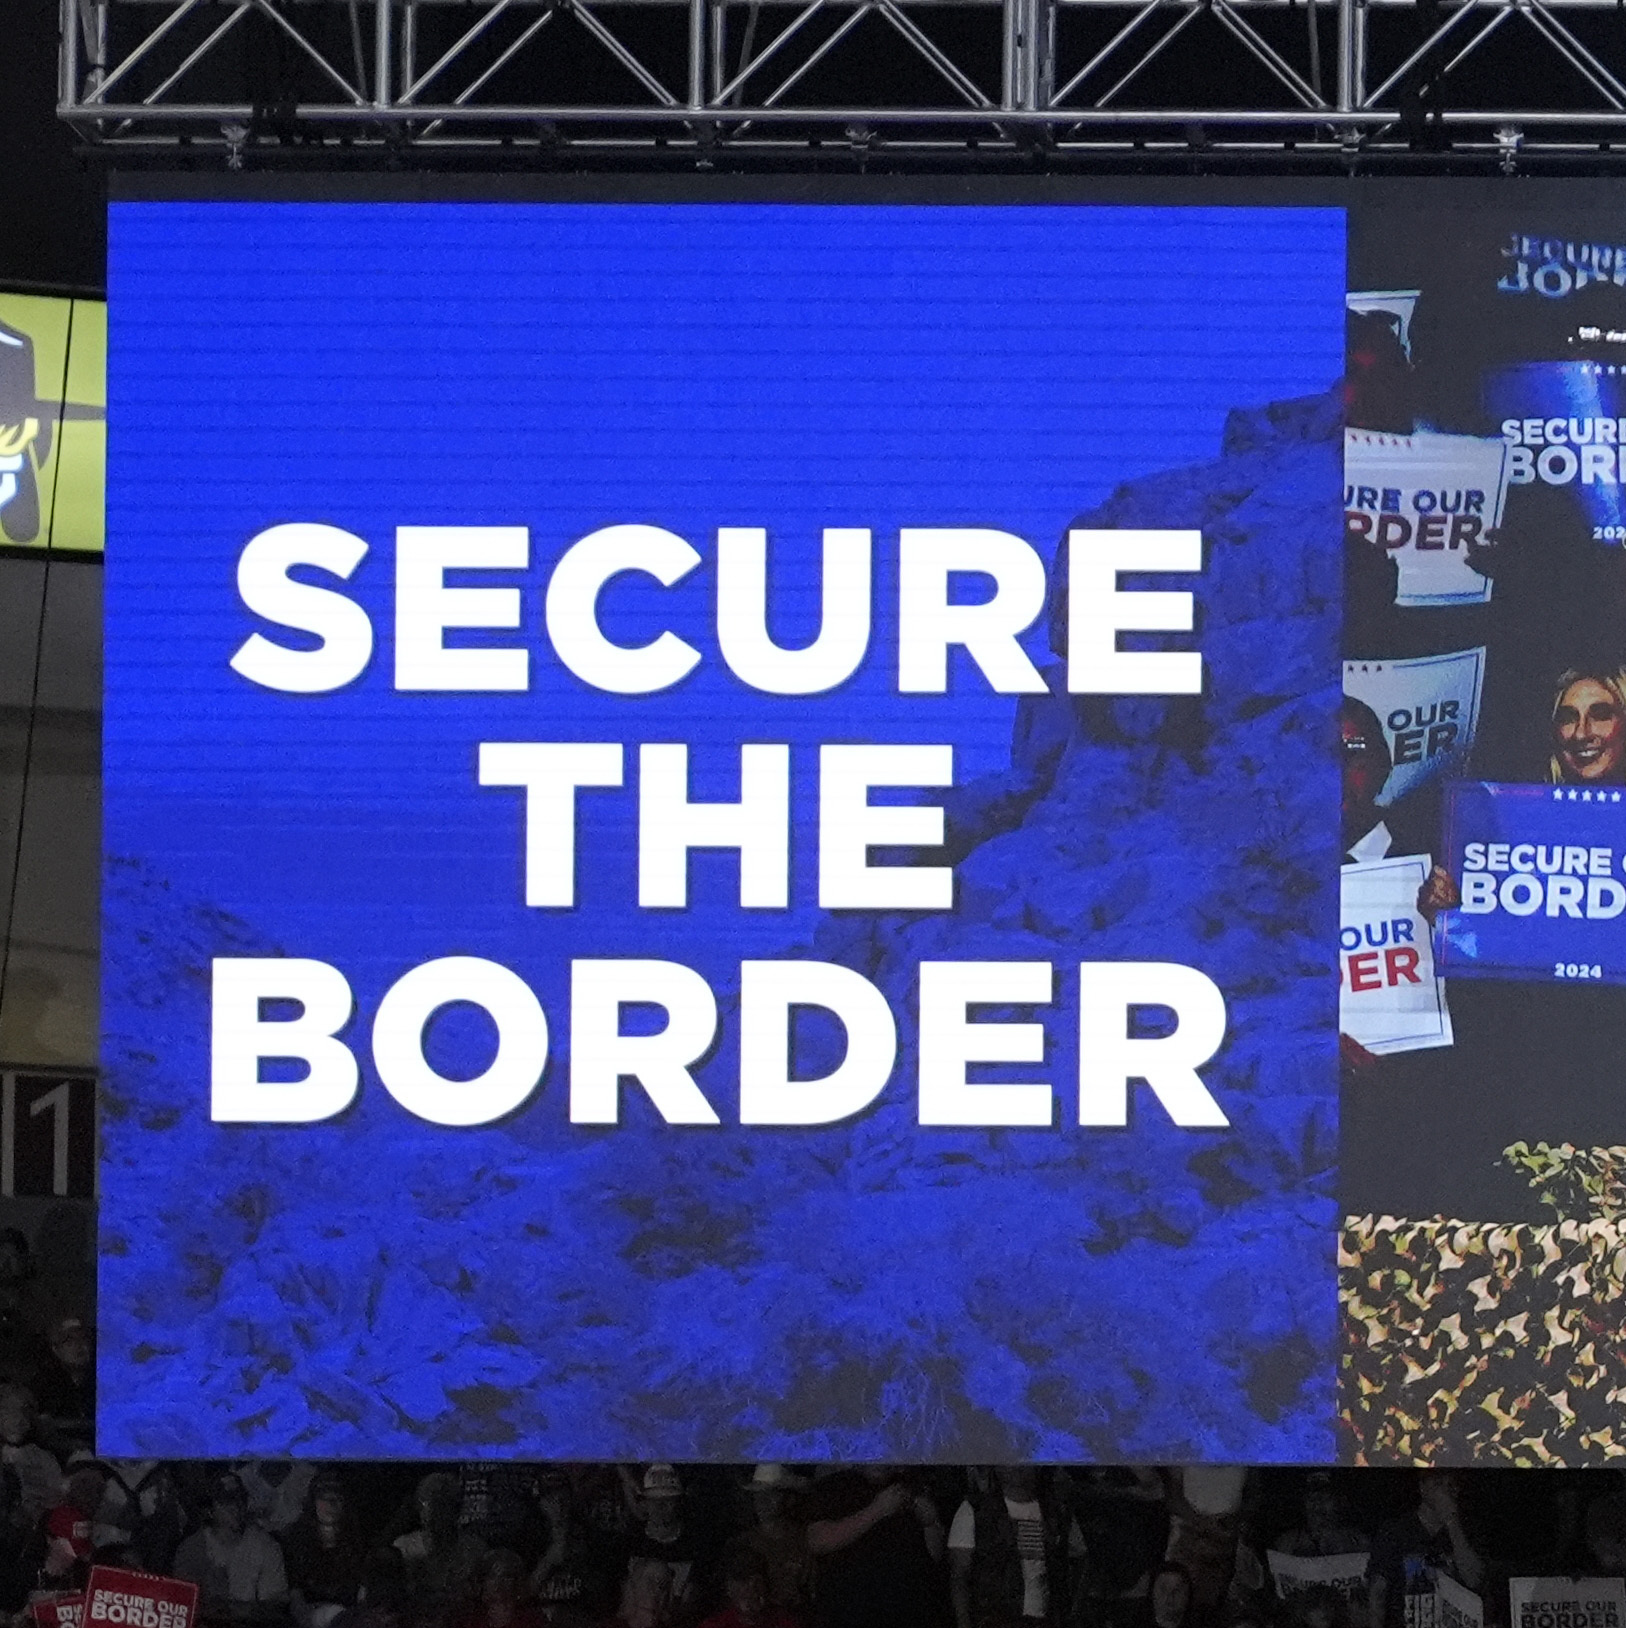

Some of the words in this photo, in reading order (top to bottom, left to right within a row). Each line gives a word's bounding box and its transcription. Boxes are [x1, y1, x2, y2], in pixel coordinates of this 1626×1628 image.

[230, 523, 1201, 694] SECURE
[478, 743, 953, 907] THE
[210, 957, 1230, 1126] BORDER
[1555, 962, 1602, 979] 2024
[94, 1589, 153, 1613] SECURE
[158, 1599, 188, 1618] OUR
